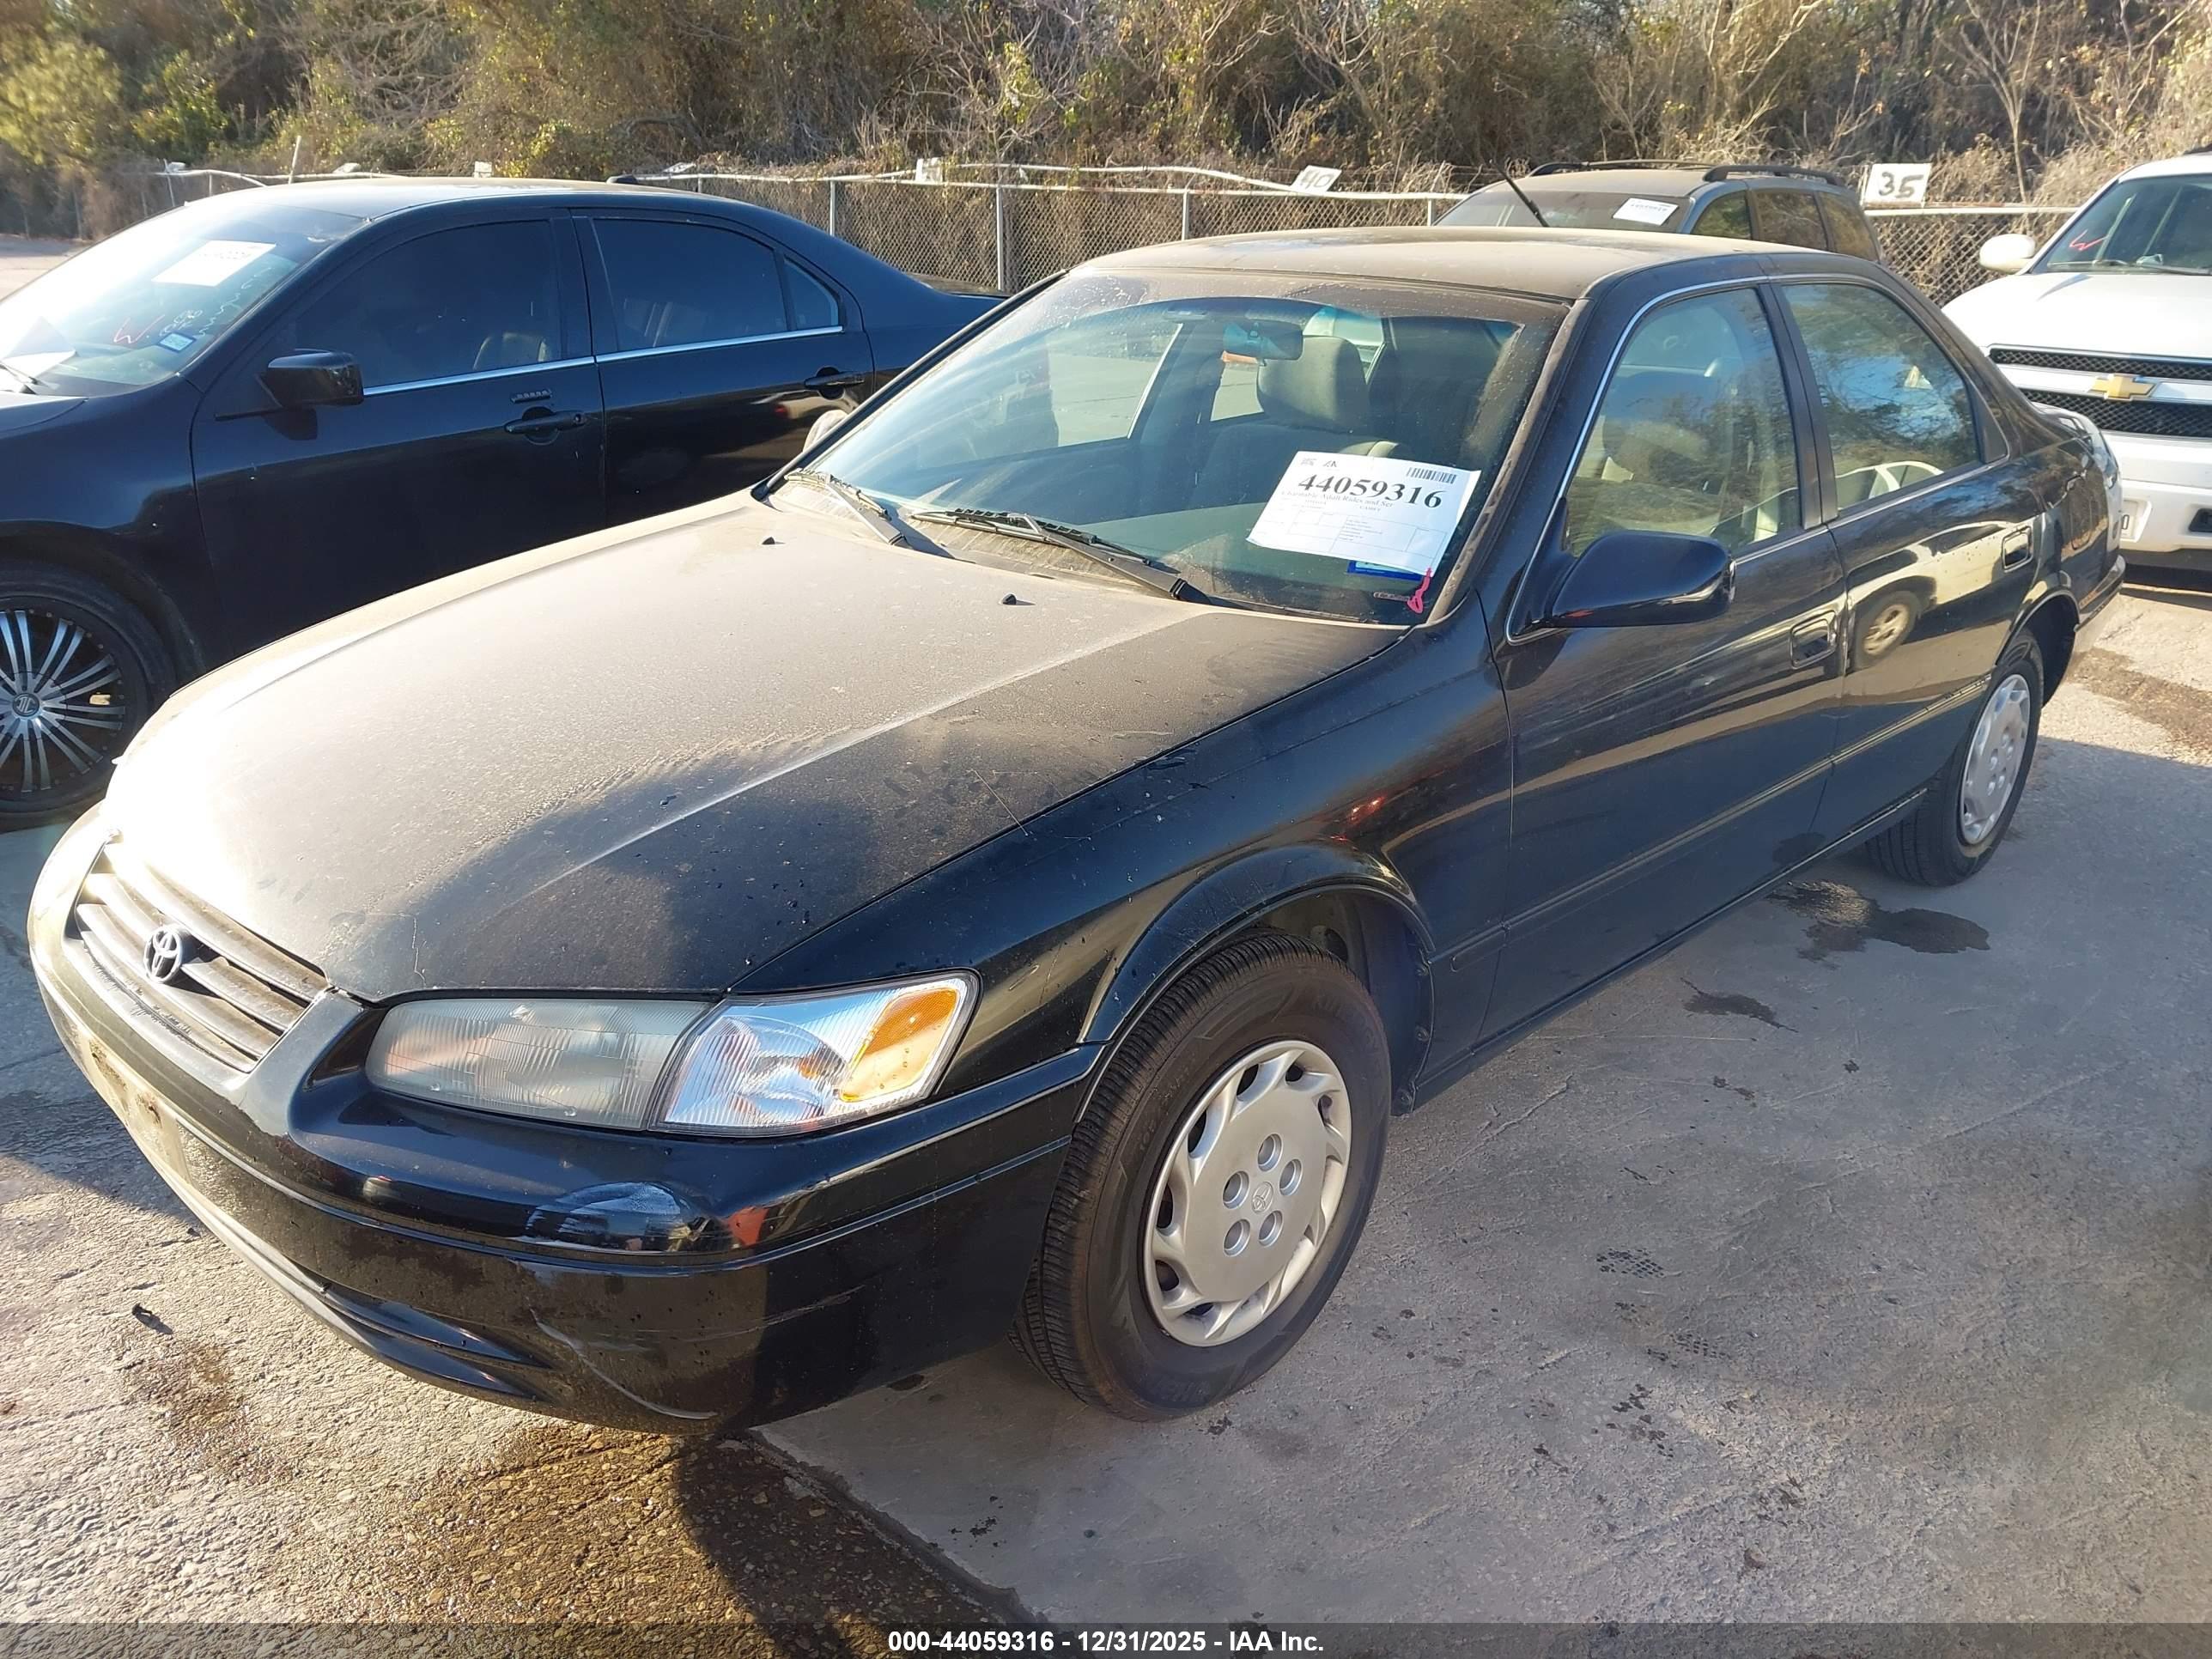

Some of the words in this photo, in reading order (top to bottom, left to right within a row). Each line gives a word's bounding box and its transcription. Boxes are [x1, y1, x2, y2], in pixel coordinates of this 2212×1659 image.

[1878, 172, 1924, 198] 35
[1297, 473, 1448, 508] 44059316
[1342, 495, 1364, 504] Rides
